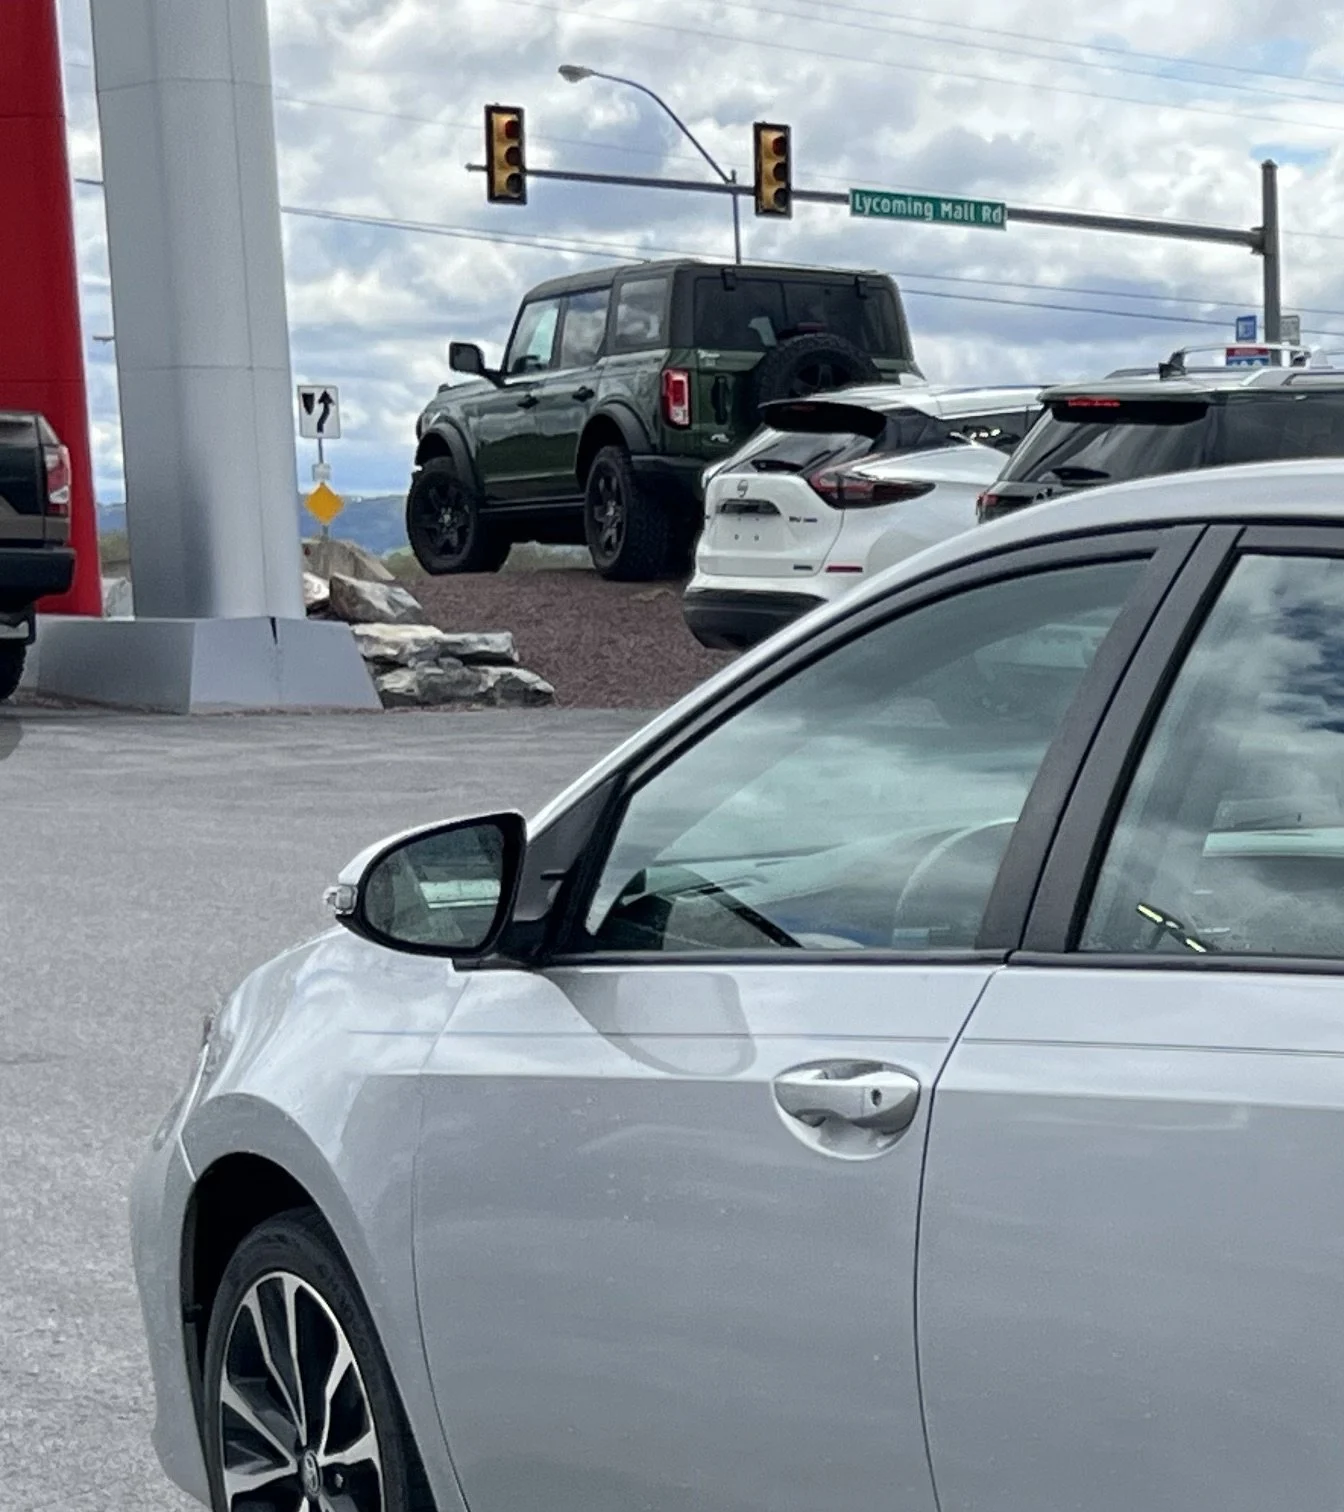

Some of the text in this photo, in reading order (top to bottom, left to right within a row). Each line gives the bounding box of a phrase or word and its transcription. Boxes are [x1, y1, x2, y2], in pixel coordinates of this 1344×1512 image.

[855, 193, 1003, 224] Lycoming Mall Rd
